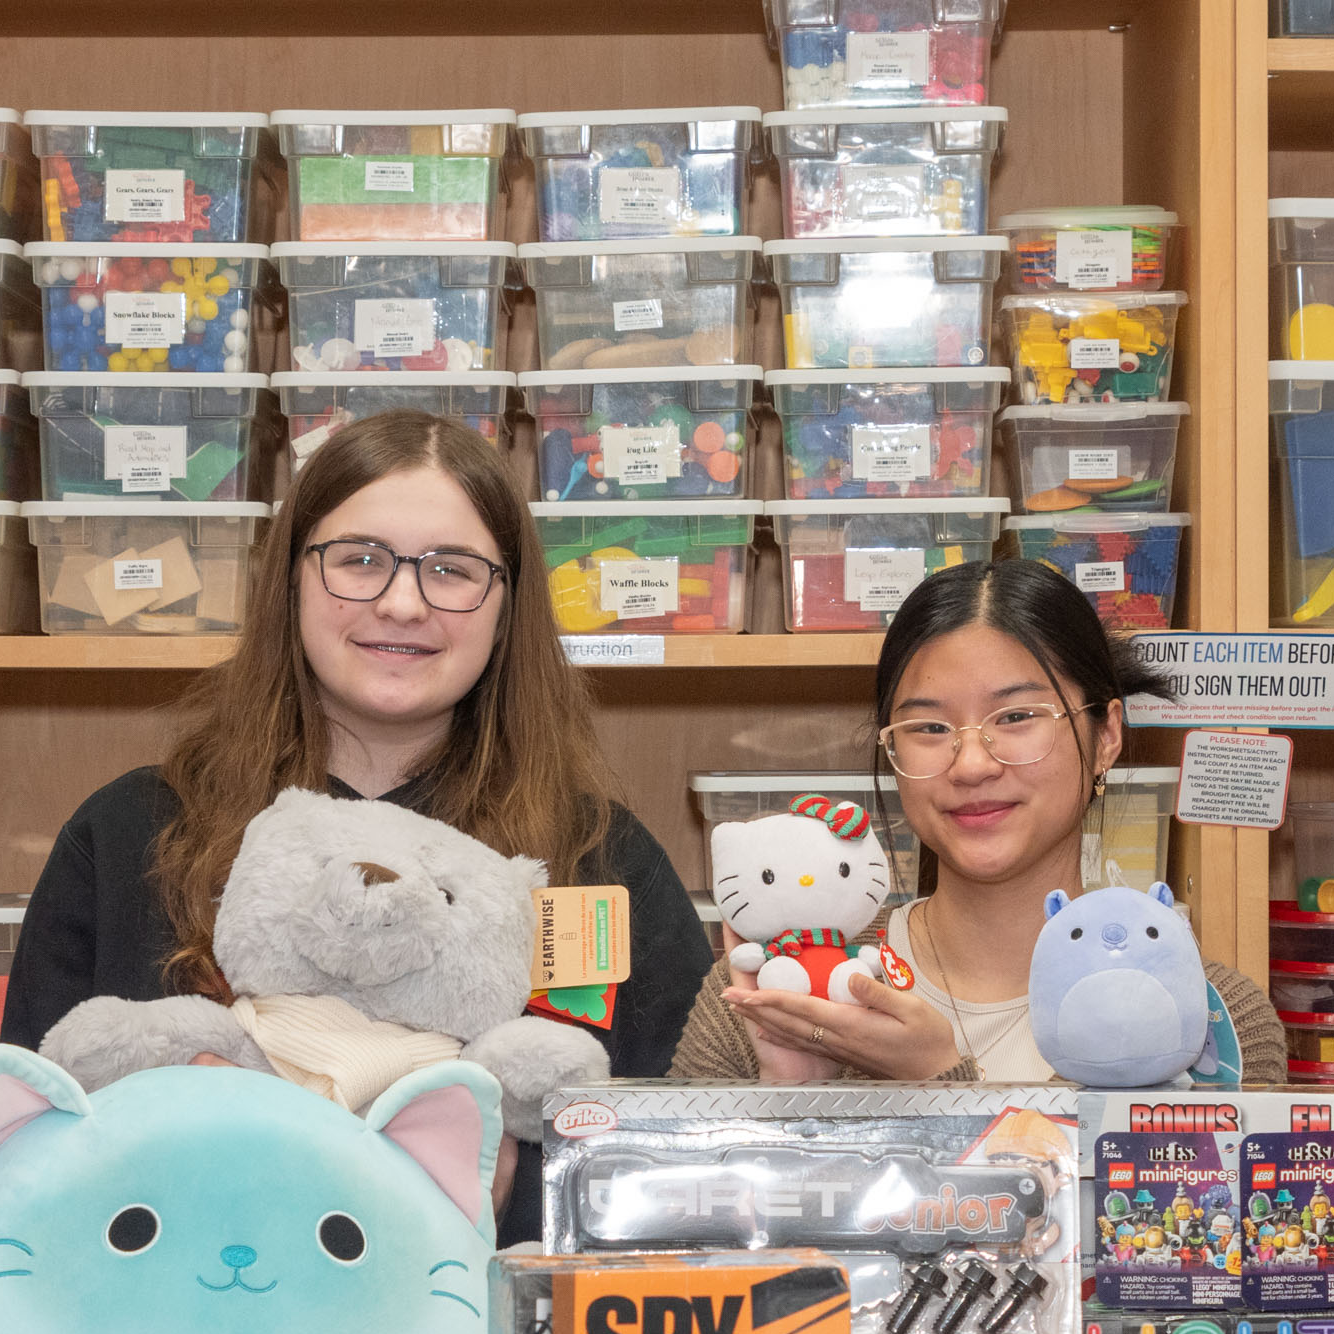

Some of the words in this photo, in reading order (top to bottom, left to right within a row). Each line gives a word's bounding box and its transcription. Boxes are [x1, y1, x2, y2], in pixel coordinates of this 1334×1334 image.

[113, 311, 150, 319] Snowflake
[152, 311, 175, 319] Blocks
[609, 579, 641, 589] Waffle
[643, 579, 669, 590] Blocks
[1194, 642, 1239, 662] EACH
[1243, 642, 1283, 664] ITEM
[1194, 675, 1233, 696] SIGN
[1237, 676, 1283, 697] THEM
[1289, 676, 1327, 698] OUT!
[1189, 704, 1211, 713] pieces
[1245, 704, 1269, 714] missing
[1271, 704, 1293, 712] before
[1246, 713, 1277, 721] condition
[1209, 736, 1241, 744] PLEASE
[1243, 737, 1267, 746] NOTE:
[1187, 752, 1230, 760] INSTRUCTIONS
[1187, 774, 1229, 782] PHOTOCOPIES
[1192, 797, 1234, 806] REPLACEMENT
[1179, 812, 1219, 820] WORKSHEETS
[1241, 808, 1268, 816] ORIGINAL
[543, 899, 555, 967] EARTHWISE
[561, 1109, 611, 1131] triko
[1291, 1104, 1331, 1132] EN
[1103, 1142, 1117, 1150] 5+
[1247, 1142, 1261, 1152] 5+
[1110, 1170, 1133, 1180] LEGO
[1139, 1164, 1237, 1186] minifigures
[1253, 1171, 1274, 1181] LEGO
